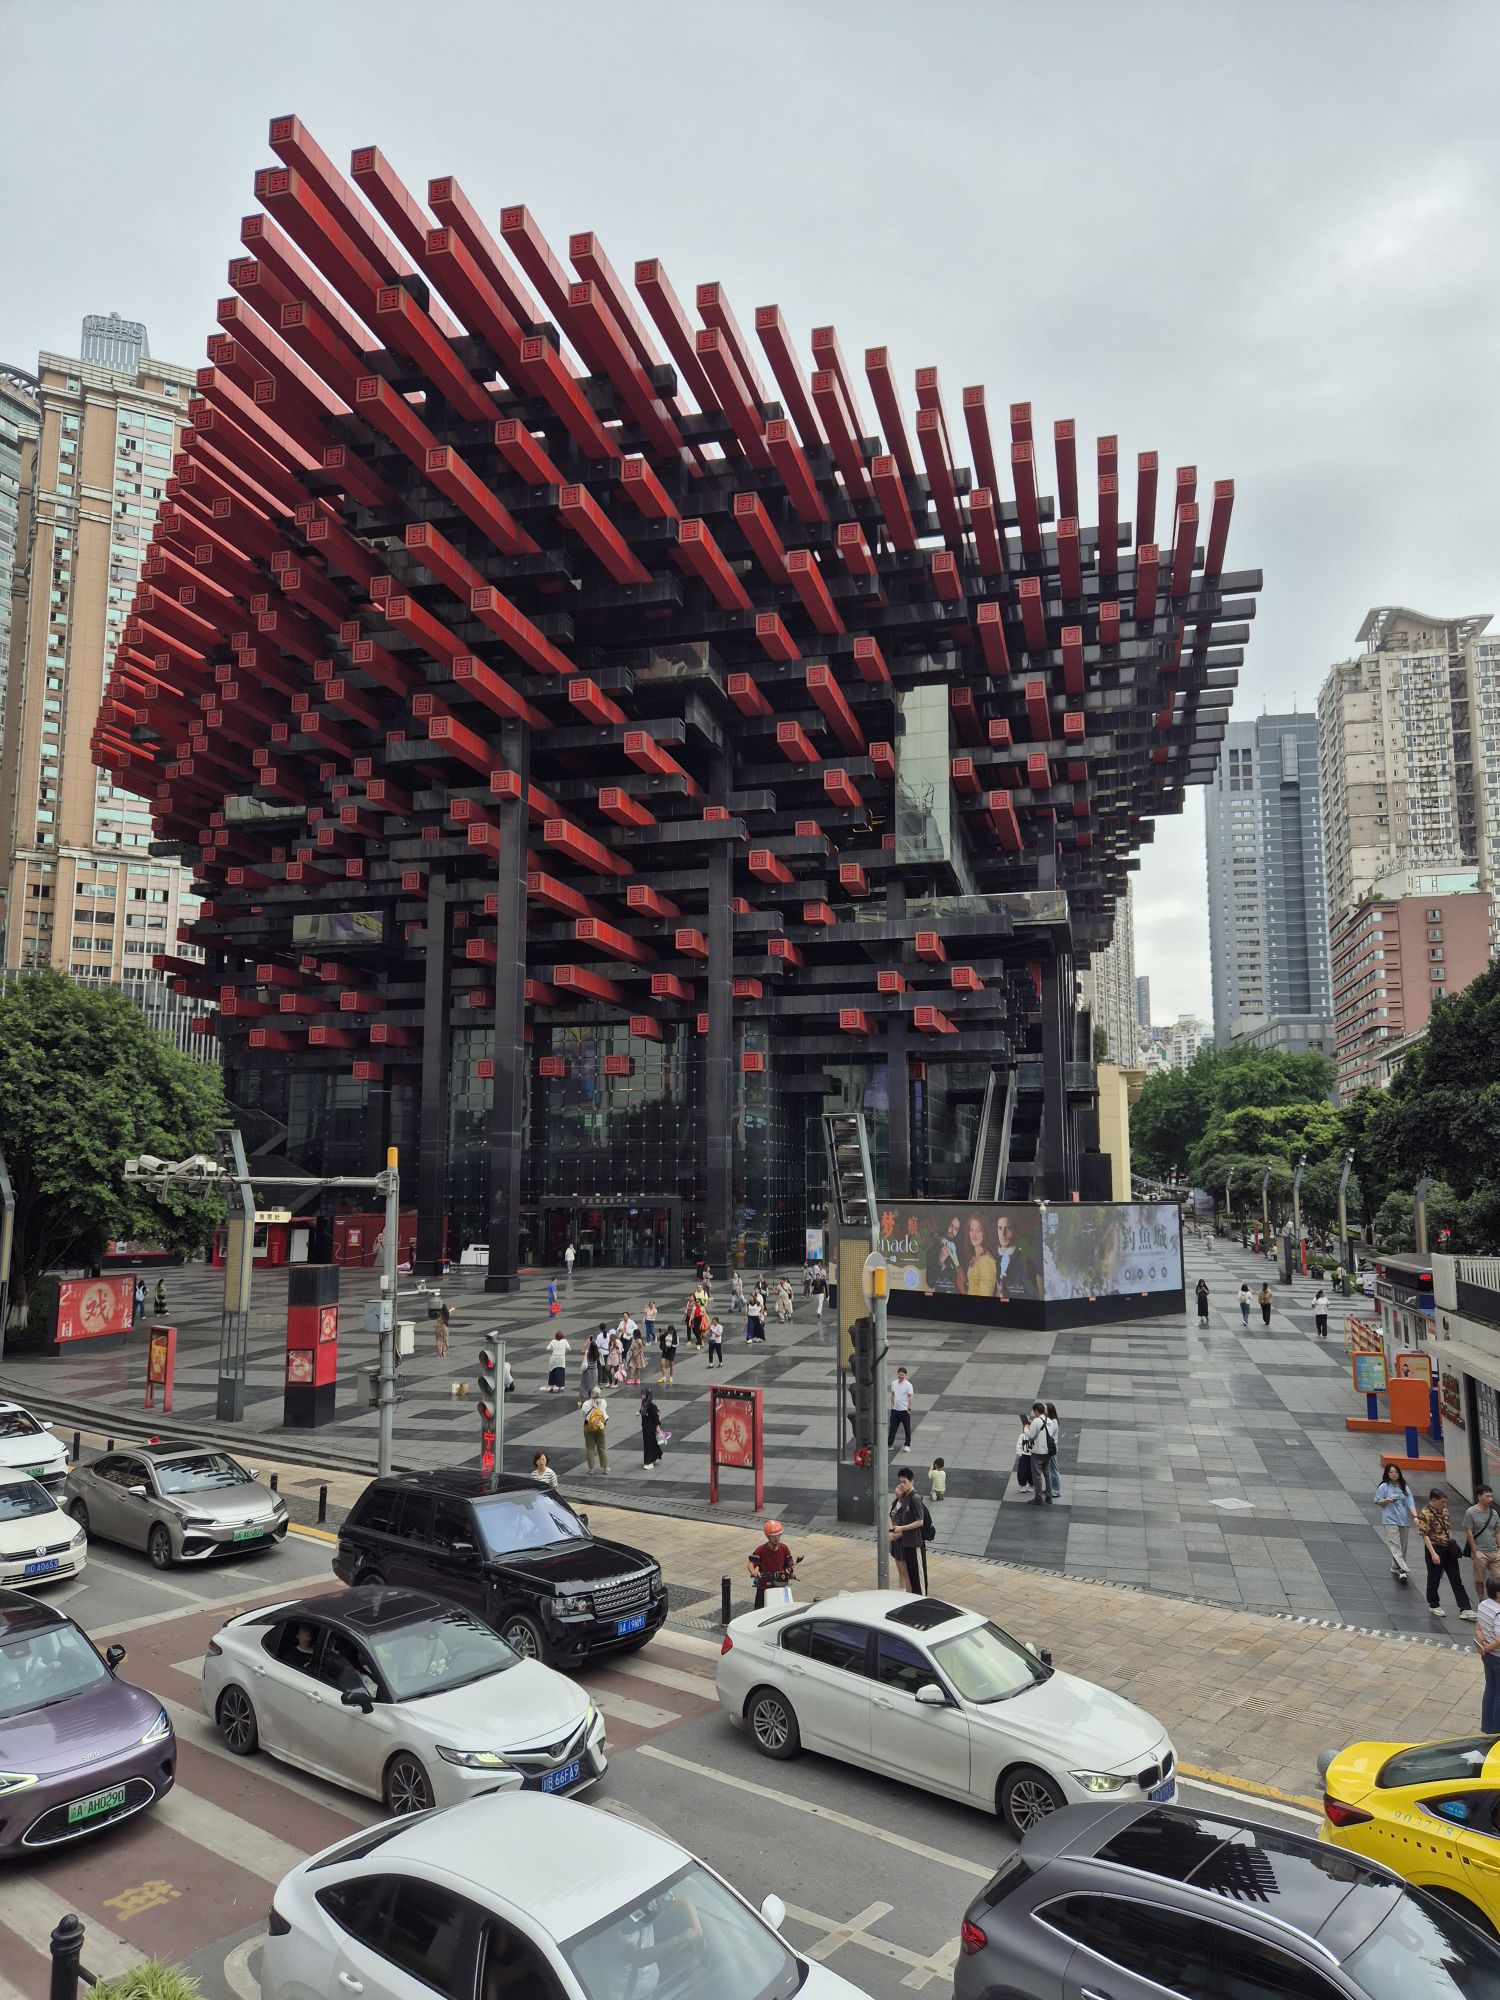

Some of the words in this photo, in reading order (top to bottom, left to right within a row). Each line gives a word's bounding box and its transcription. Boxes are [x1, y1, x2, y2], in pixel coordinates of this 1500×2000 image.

[259, 1213, 281, 1221] 售票处
[878, 1234, 919, 1253] nade
[1122, 1224, 1168, 1251] 釣魚城
